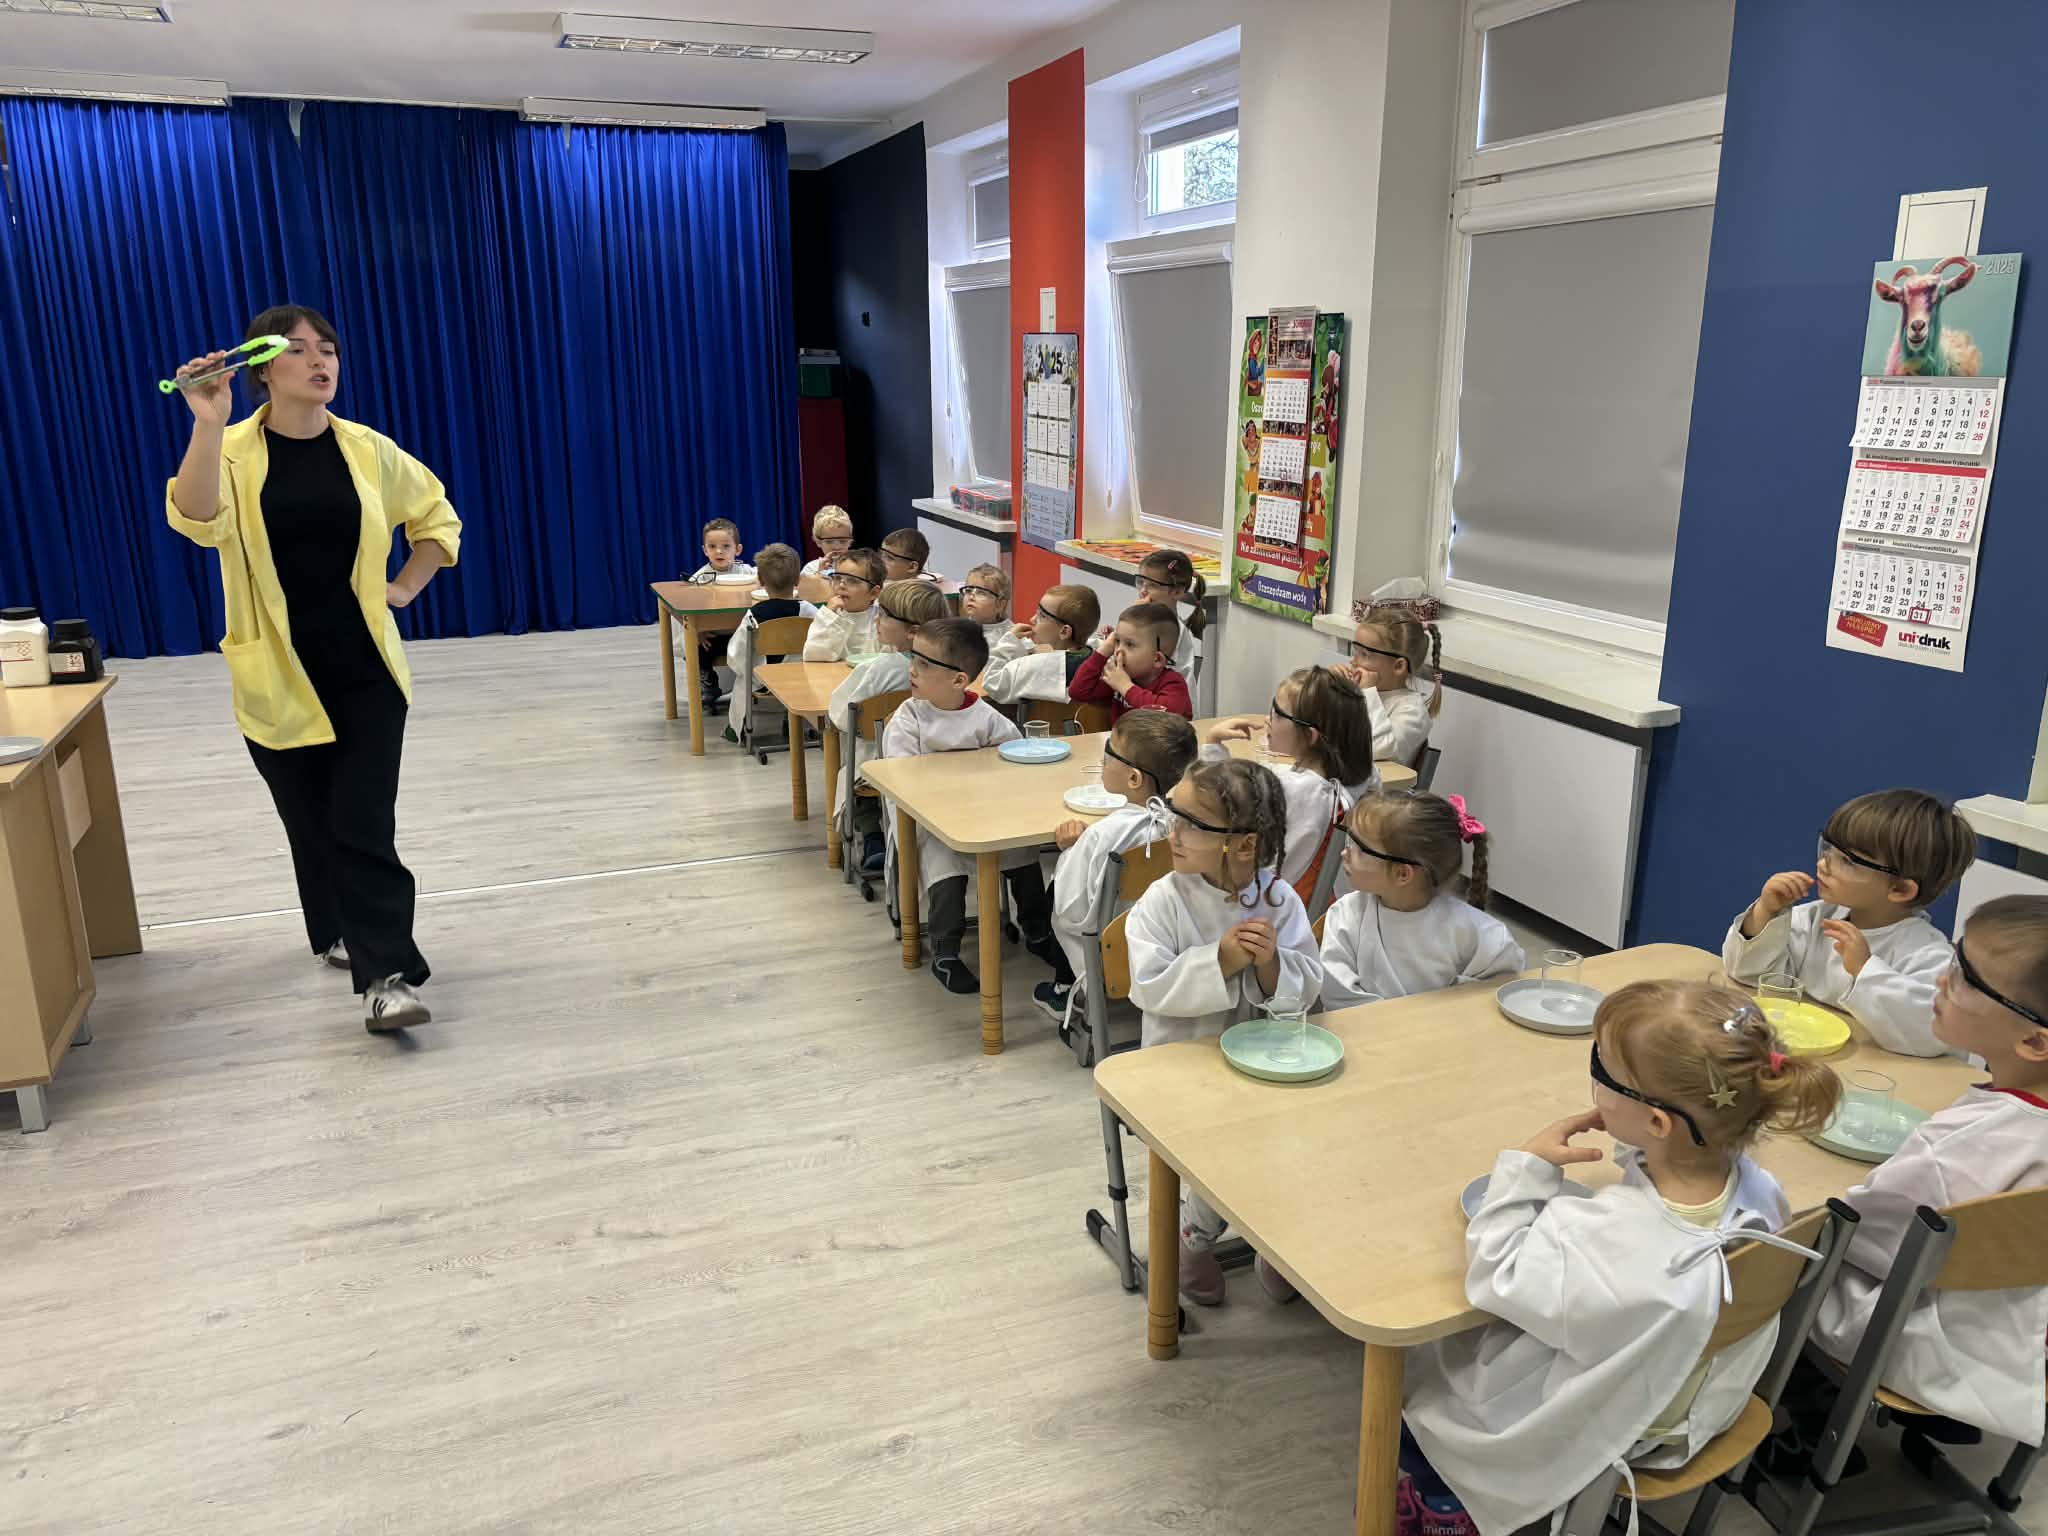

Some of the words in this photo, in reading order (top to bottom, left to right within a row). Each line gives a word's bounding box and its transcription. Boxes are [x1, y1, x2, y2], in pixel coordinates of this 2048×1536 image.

[1917, 396, 1921, 404] 1
[1933, 396, 1939, 404] 2
[1950, 396, 1956, 405] 3
[1968, 397, 1973, 405] 4
[1985, 398, 1991, 406] 5
[1882, 405, 1888, 414] 6
[1897, 406, 1903, 415] 7
[1931, 407, 1937, 416] 9
[1945, 408, 1954, 417] 10
[1962, 408, 1970, 417] 11
[1979, 409, 1990, 418] 12
[1876, 416, 1886, 425] 13
[1892, 417, 1901, 425] 14
[1909, 418, 1918, 426] 15
[1925, 419, 1934, 427] 16
[1942, 419, 1952, 428] 17
[1960, 420, 1969, 429] 18
[1977, 421, 1987, 430] 19
[1872, 427, 1882, 435] 20
[1888, 428, 1898, 436] 21
[1903, 429, 1915, 437] 22
[1920, 430, 1932, 438] 23
[1937, 431, 1948, 439] 24
[1954, 432, 1966, 440] 25
[1867, 438, 1879, 446] 27
[1899, 440, 1911, 448] 29
[1917, 441, 1928, 449] 30
[1933, 442, 1944, 450] 31
[1870, 488, 1876, 496] 4
[1887, 489, 1893, 498] 5
[1918, 492, 1925, 501] 7
[1952, 496, 1958, 504] 9
[1966, 497, 1975, 506] 10
[1938, 483, 1943, 492] 1
[1954, 484, 1960, 493] 2
[1972, 486, 1978, 495] 3
[1865, 499, 1873, 507] 11
[1881, 500, 1891, 509] 12
[1897, 502, 1906, 511] 13
[1913, 503, 1922, 512] 14
[1963, 509, 1974, 519] 17
[1879, 511, 1888, 520] 19
[1893, 512, 1904, 521] 20
[1908, 514, 1919, 524] 21
[1925, 516, 1936, 525] 22
[1941, 518, 1953, 527] 23
[1959, 520, 1970, 529] 24
[1874, 522, 1885, 530] 26
[1890, 523, 1901, 532] 27
[1906, 525, 1917, 534] 28
[1922, 527, 1933, 536] 29
[1939, 529, 1950, 538] 30
[1955, 531, 1967, 540] 31
[1892, 564, 1896, 572] 1
[1908, 566, 1914, 575] 2
[1924, 568, 1930, 577] 3
[1941, 571, 1947, 579] 4
[1958, 573, 1965, 582] 5
[1855, 580, 1863, 588] 13
[1870, 582, 1878, 590] 14
[1886, 585, 1895, 593] 15
[1918, 589, 1928, 598] 17
[1873, 572, 1879, 580] 7
[1907, 577, 1912, 585] 9
[1920, 579, 1929, 587] 10
[1936, 582, 1945, 590] 11
[1954, 584, 1963, 593] 12
[1850, 600, 1860, 609] 27
[1880, 606, 1891, 614] 29
[1896, 608, 1907, 617] 30
[1913, 611, 1923, 619] 31
[1852, 590, 1862, 599] 20
[1867, 593, 1877, 601] 21
[1883, 595, 1893, 604] 22
[1899, 598, 1910, 606] 23
[1914, 601, 1926, 609] 24
[1932, 603, 1943, 612] 25
